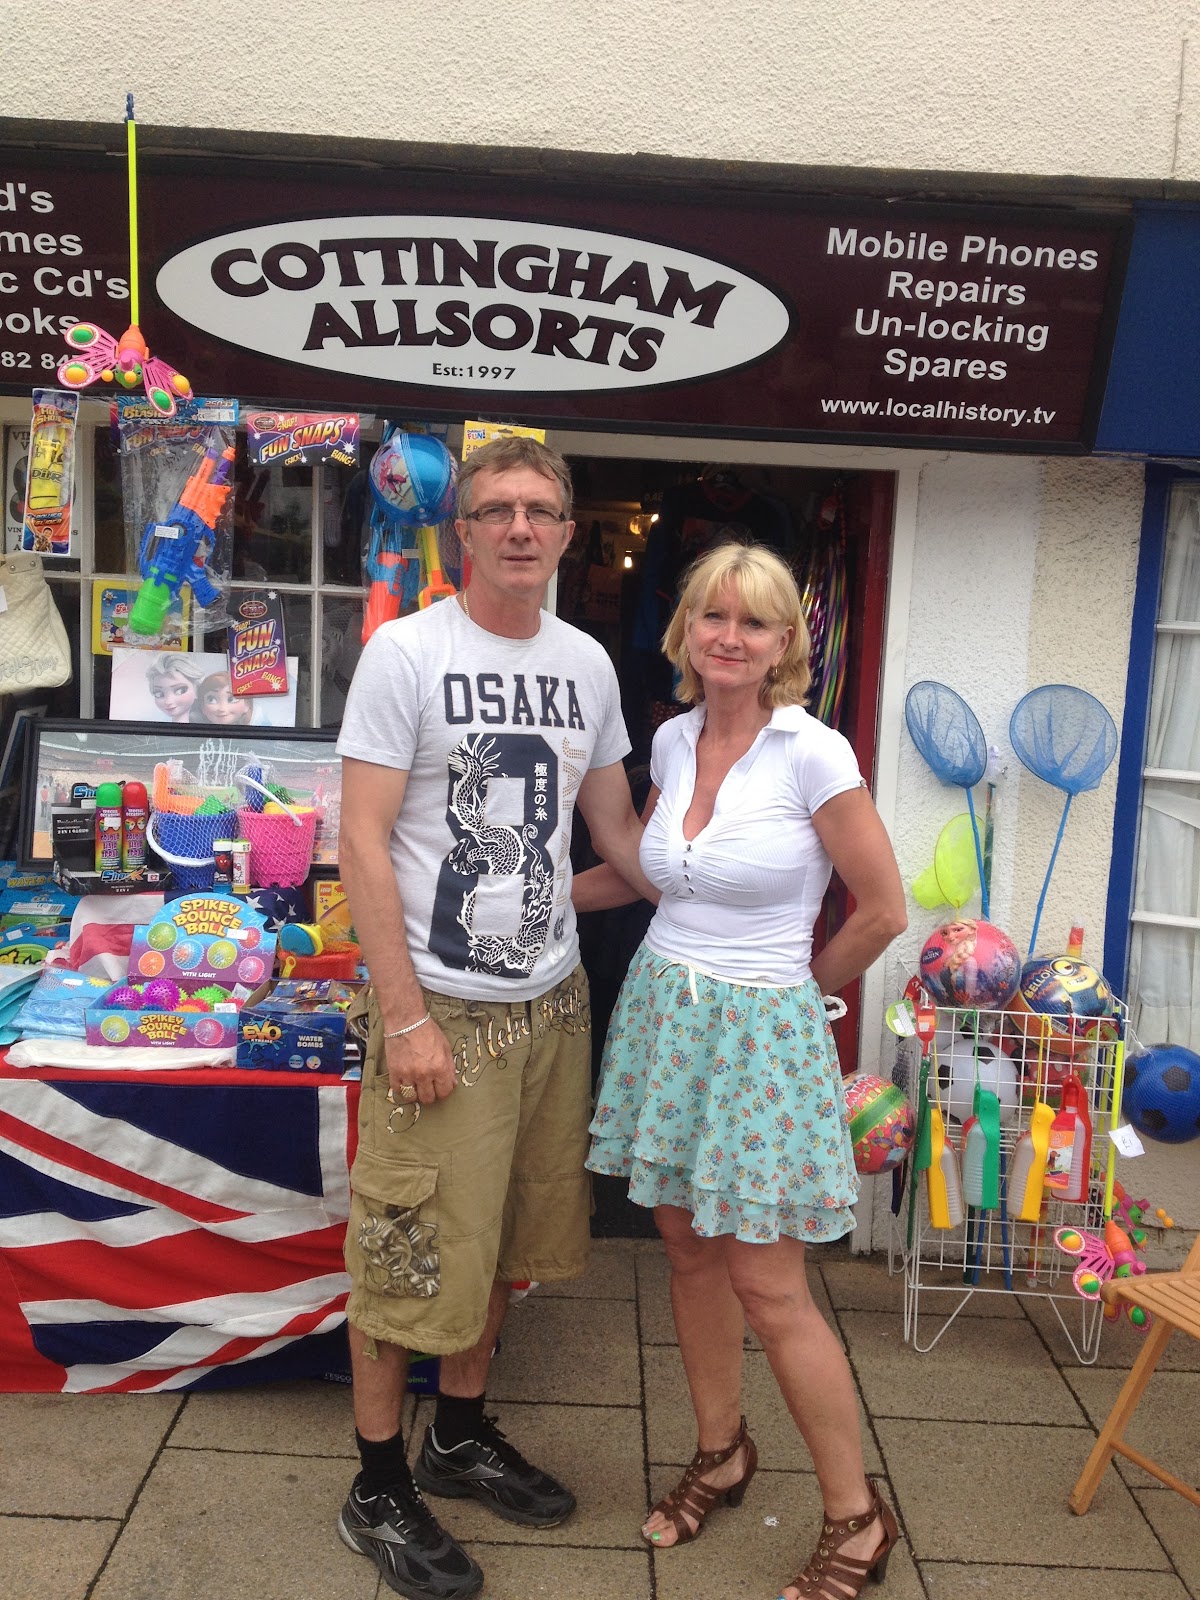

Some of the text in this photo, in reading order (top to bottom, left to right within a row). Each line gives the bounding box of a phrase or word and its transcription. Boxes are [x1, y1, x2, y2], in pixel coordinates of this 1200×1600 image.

[826, 227, 1098, 271] Mobile Phones
[33, 266, 130, 300] Cd's
[210, 236, 737, 329] COTTINGHAM
[887, 270, 1026, 308] Repairs
[301, 299, 666, 373] ALLSORTS
[854, 307, 1049, 352] Un-locking
[883, 348, 1008, 382] Spares
[820, 397, 1056, 427] www.localhistory.tv
[261, 419, 345, 462] FUN SNAPS
[330, 448, 356, 467] BANG!
[236, 621, 274, 656] FUN
[236, 647, 278, 677] SNAPS
[443, 672, 586, 731] OSAKA
[534, 762, 548, 821] 極度の糸
[173, 911, 242, 929] BOUNCE
[180, 899, 240, 914] SPIKEY
[185, 922, 226, 938] BALL
[137, 1022, 187, 1035] BOUNCE
[140, 1014, 184, 1024] SPIKEY
[243, 1021, 282, 1041] EVO
[147, 1031, 177, 1041] BALL
[407, 1376, 428, 1384] oints
